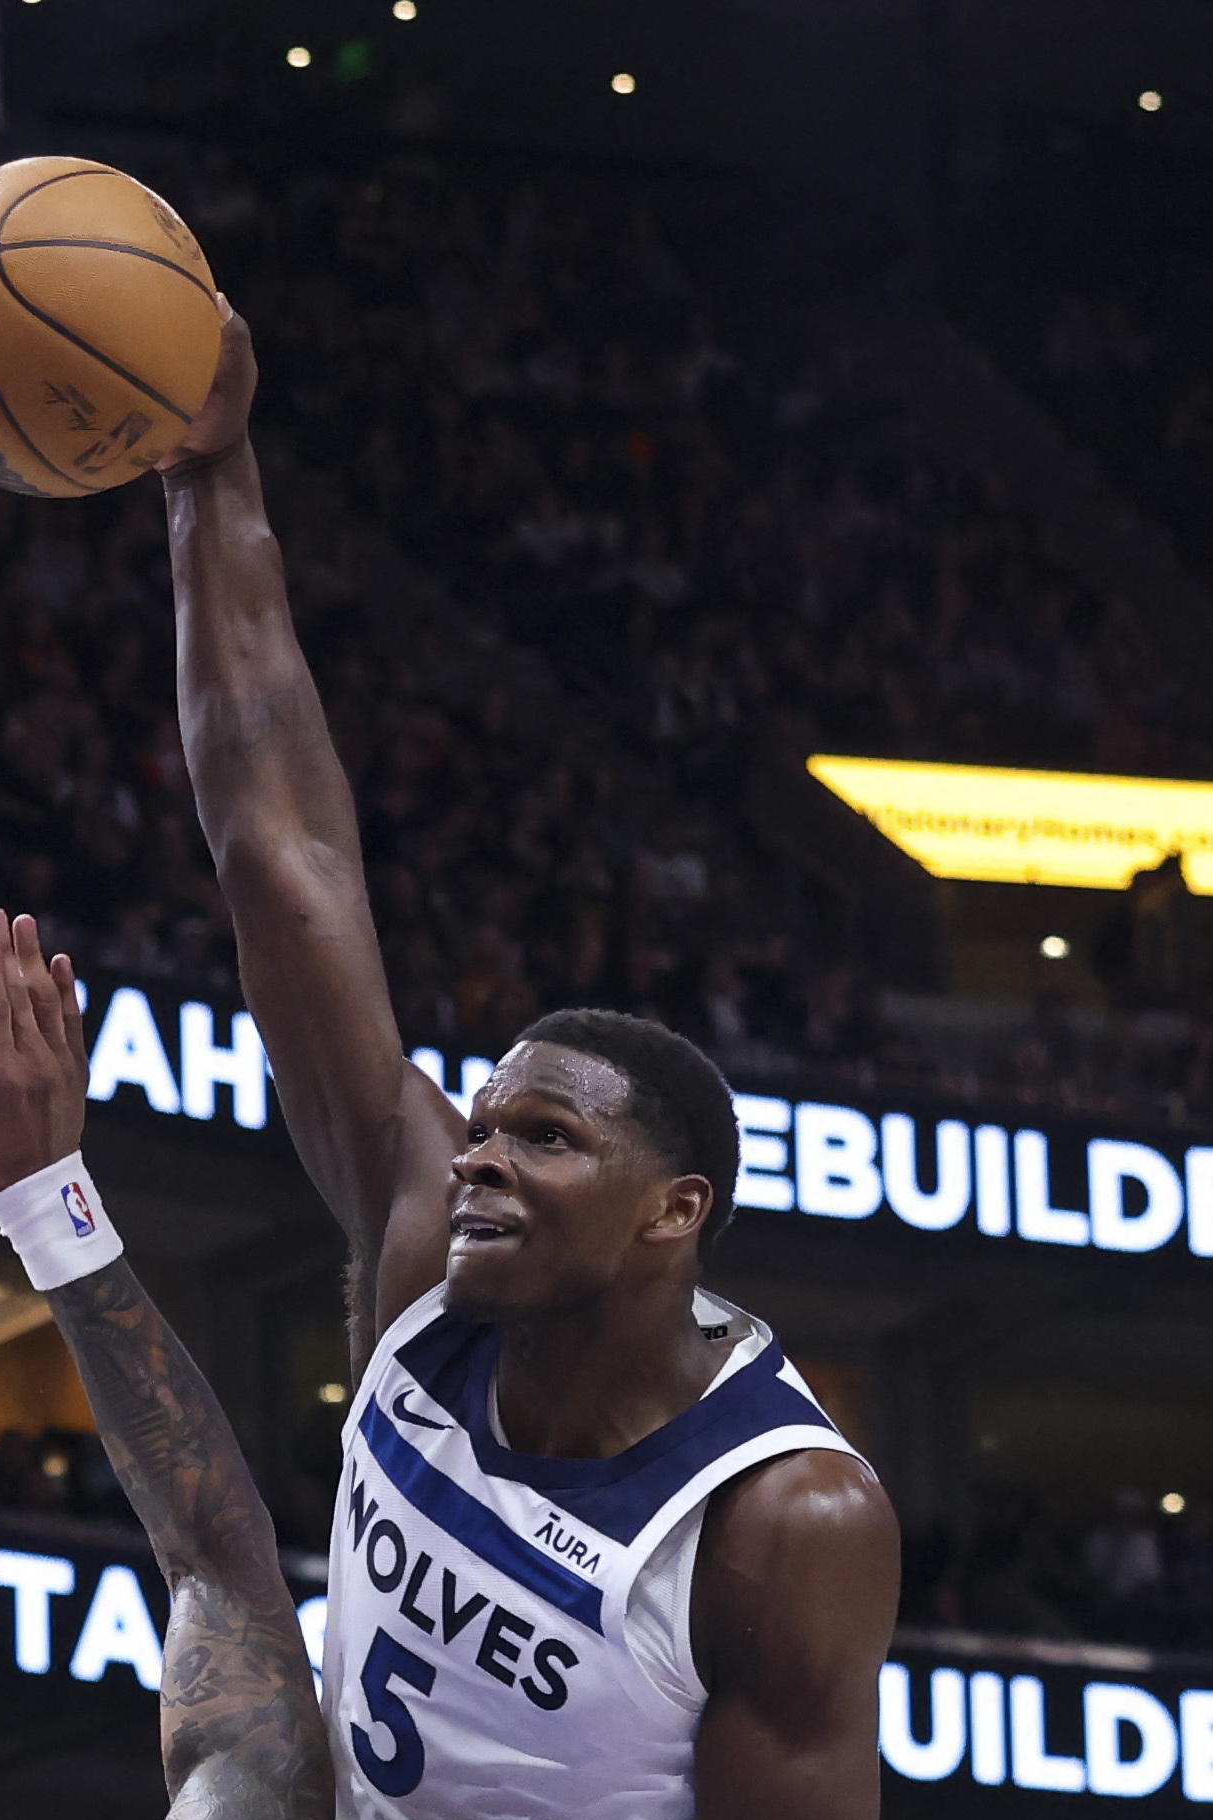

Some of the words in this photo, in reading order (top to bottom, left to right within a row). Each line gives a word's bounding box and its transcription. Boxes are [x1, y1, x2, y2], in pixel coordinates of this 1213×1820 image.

[347, 1457, 581, 1711] WOLVES
[350, 1625, 437, 1798] 5
[878, 1661, 1213, 1803] UILD
